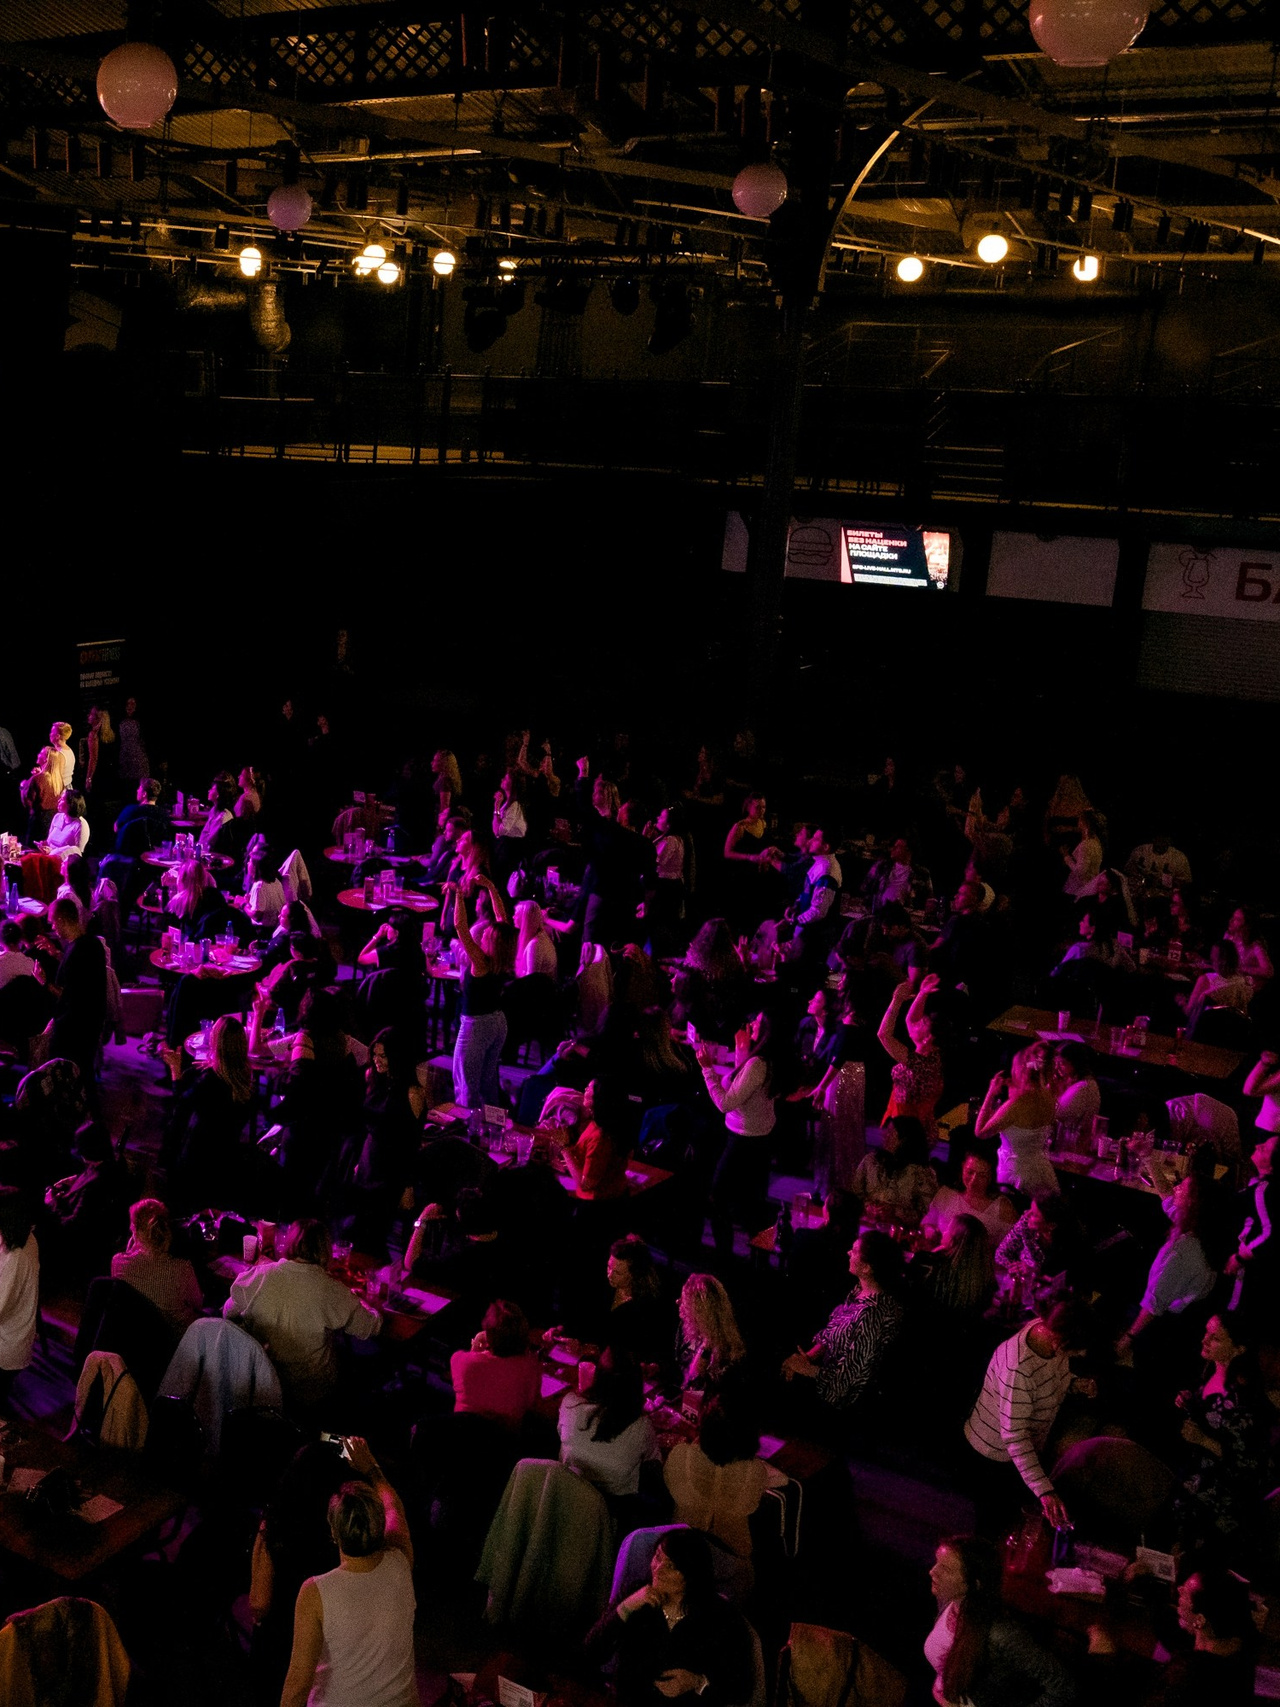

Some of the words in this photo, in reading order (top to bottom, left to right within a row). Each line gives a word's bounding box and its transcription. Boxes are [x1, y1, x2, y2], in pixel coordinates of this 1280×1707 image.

[847, 530, 883, 538] БИЛЕТЫ
[865, 538, 907, 547] НАЦЕНКИ
[861, 543, 889, 552] САЙТЕ
[850, 550, 898, 559] ПЛОЩАДКИ
[1235, 561, 1280, 604] Б
